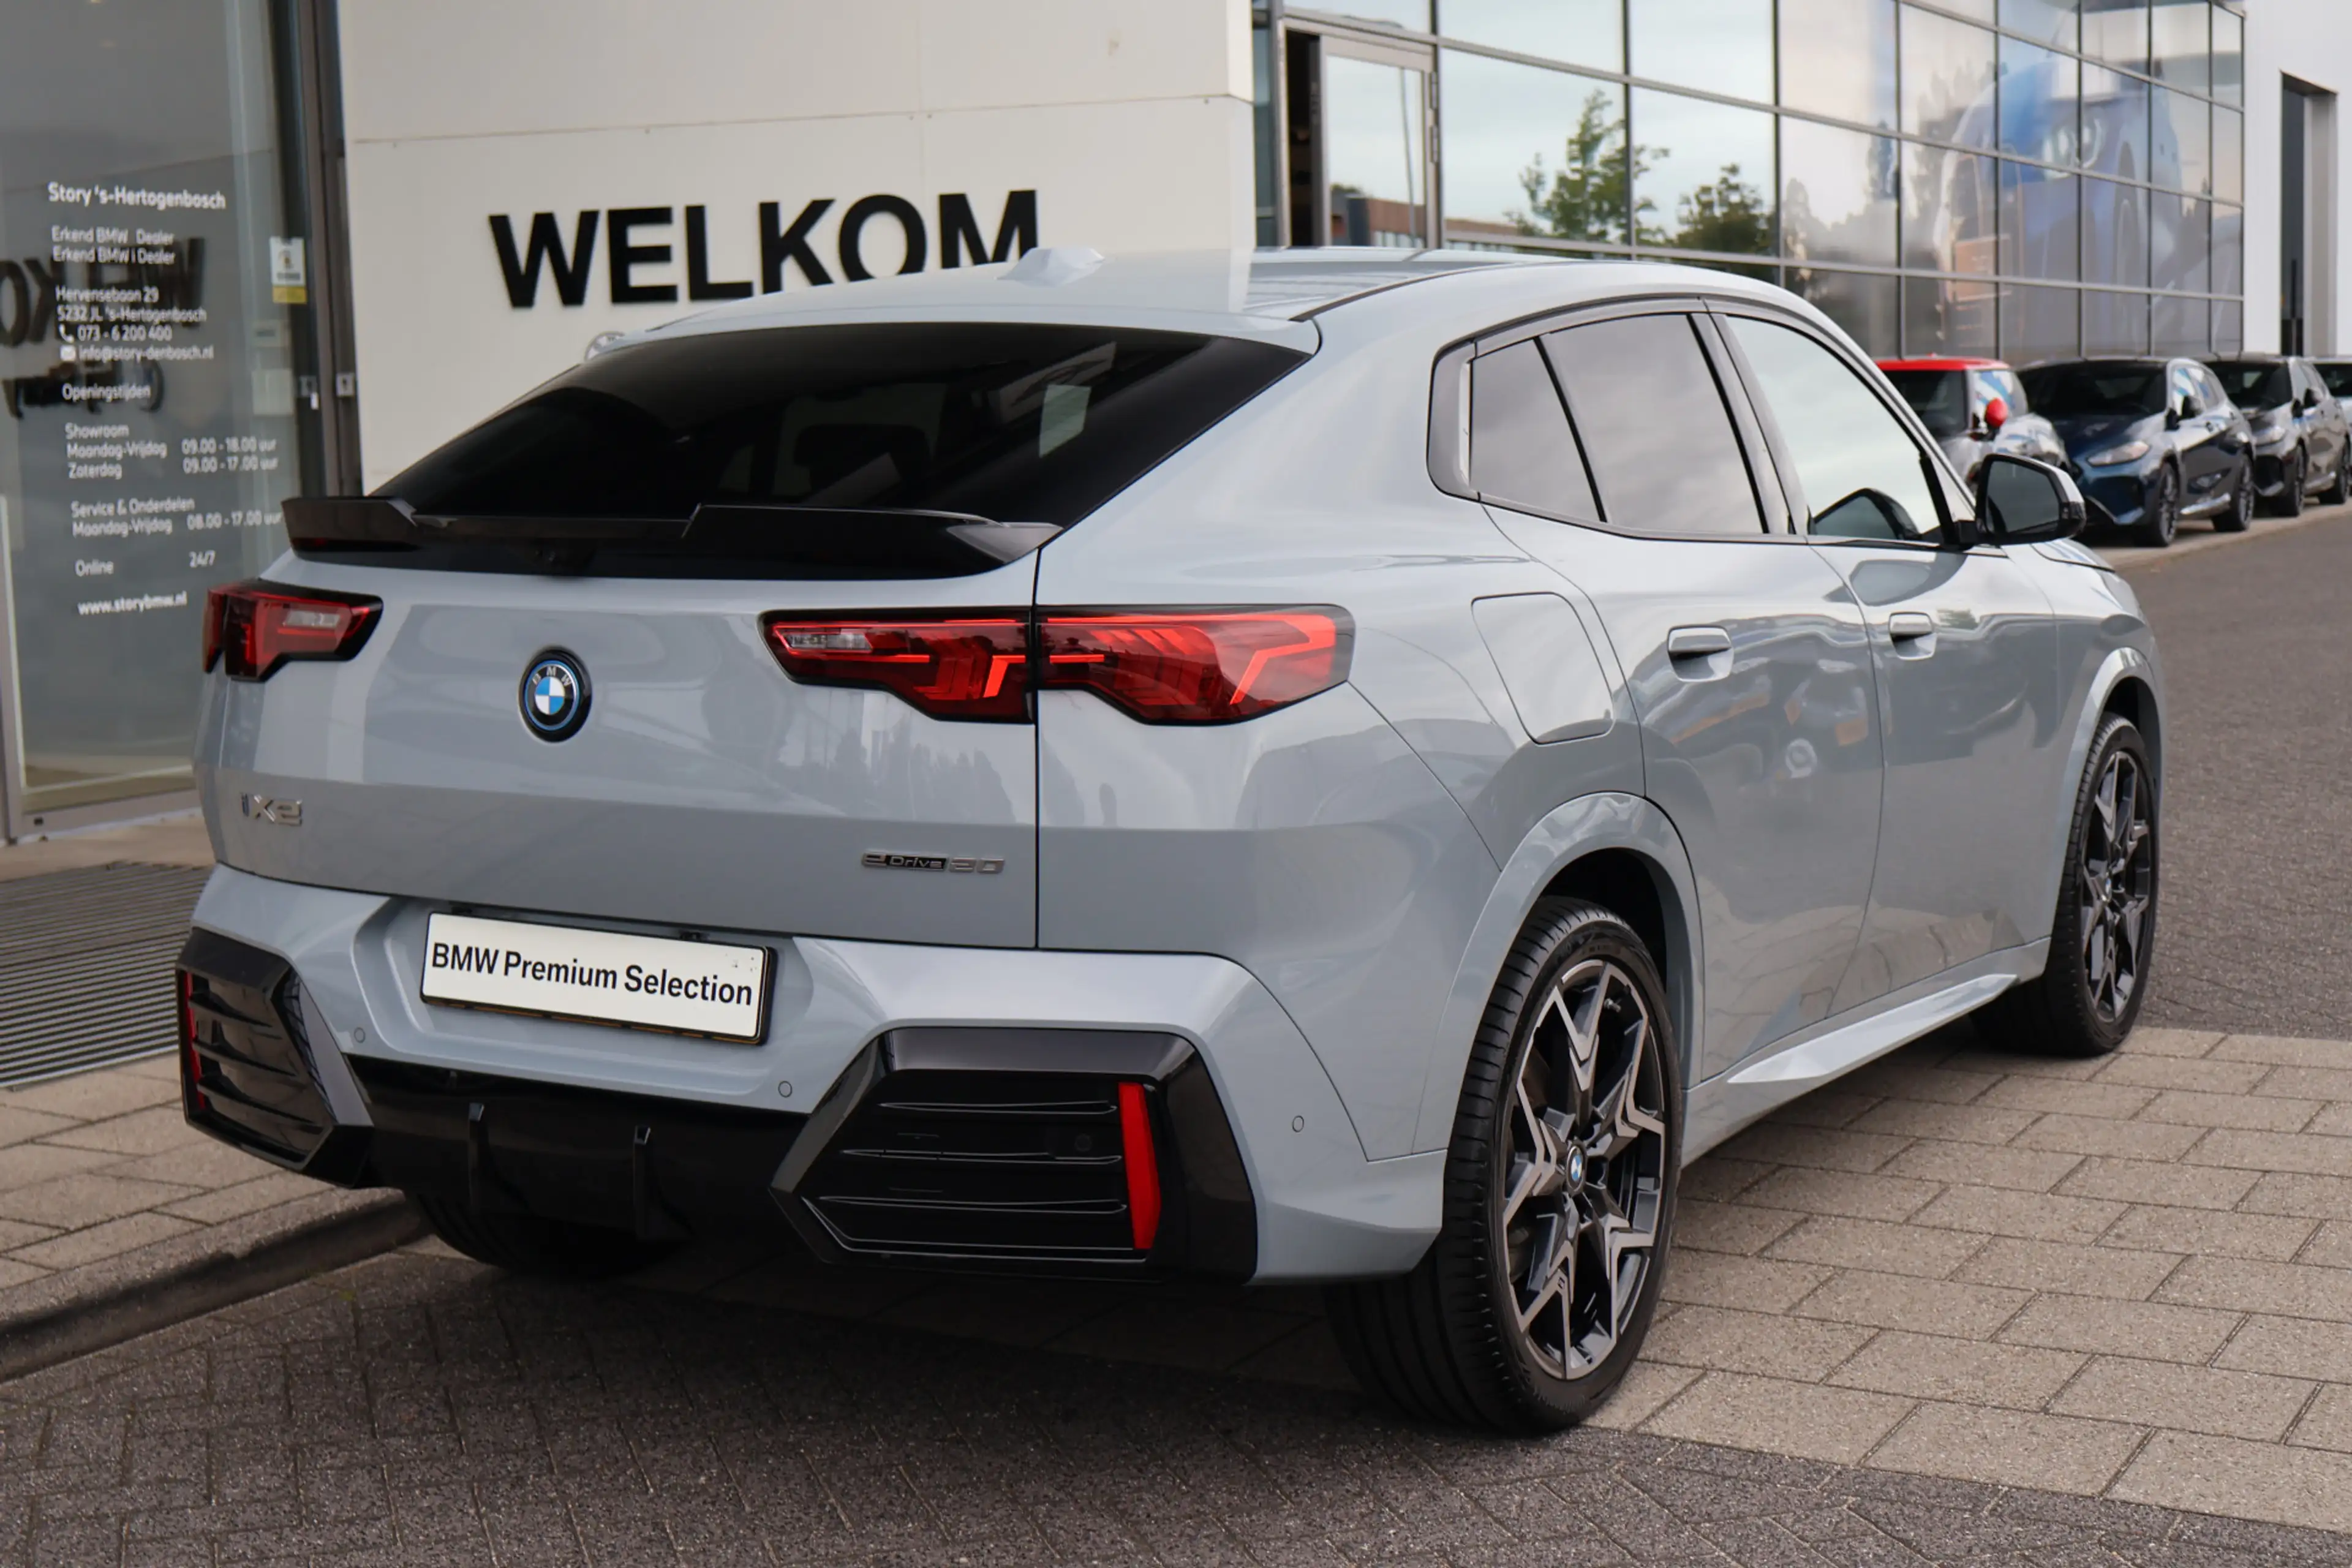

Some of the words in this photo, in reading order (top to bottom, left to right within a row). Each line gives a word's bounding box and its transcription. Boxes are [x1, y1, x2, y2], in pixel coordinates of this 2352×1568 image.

[48, 181, 92, 207] Story
[94, 184, 227, 210] 's-Hertogenbosch
[51, 225, 94, 243] Erkend
[96, 226, 129, 244] BMW
[136, 228, 175, 246] Dealer
[53, 245, 95, 263] Erkend
[97, 247, 129, 263] BMW
[137, 247, 176, 265] Dealer
[488, 189, 1039, 309] WELKOM
[55, 285, 141, 303] Hervensebaan
[143, 285, 159, 303] 29
[57, 304, 87, 322] 5232
[105, 306, 207, 325] 's-Hertogenbosch
[77, 324, 100, 342] 073
[111, 324, 120, 342] 6
[122, 324, 146, 342] 200
[148, 324, 173, 342] 400
[62, 383, 151, 403] Openingstijden
[65, 422, 129, 440] Showroom
[66, 440, 167, 461] Maandag-Vrijdag
[181, 437, 217, 454] 09.00
[225, 435, 257, 453] 18.00
[67, 461, 123, 480] Zaterdag
[183, 456, 218, 474] 09.00
[71, 500, 115, 519] Service
[116, 498, 127, 516] &
[129, 496, 195, 514] Onderdelen
[72, 516, 173, 538] Maandag-Vrijdag
[187, 512, 222, 530] 08.00
[75, 559, 114, 577] Online
[188, 549, 216, 568] 24/7
[77, 590, 187, 615] www.storybmw.nl
[431, 942, 500, 974] BMW
[503, 950, 617, 989] Premium
[624, 964, 753, 1006] Selection
